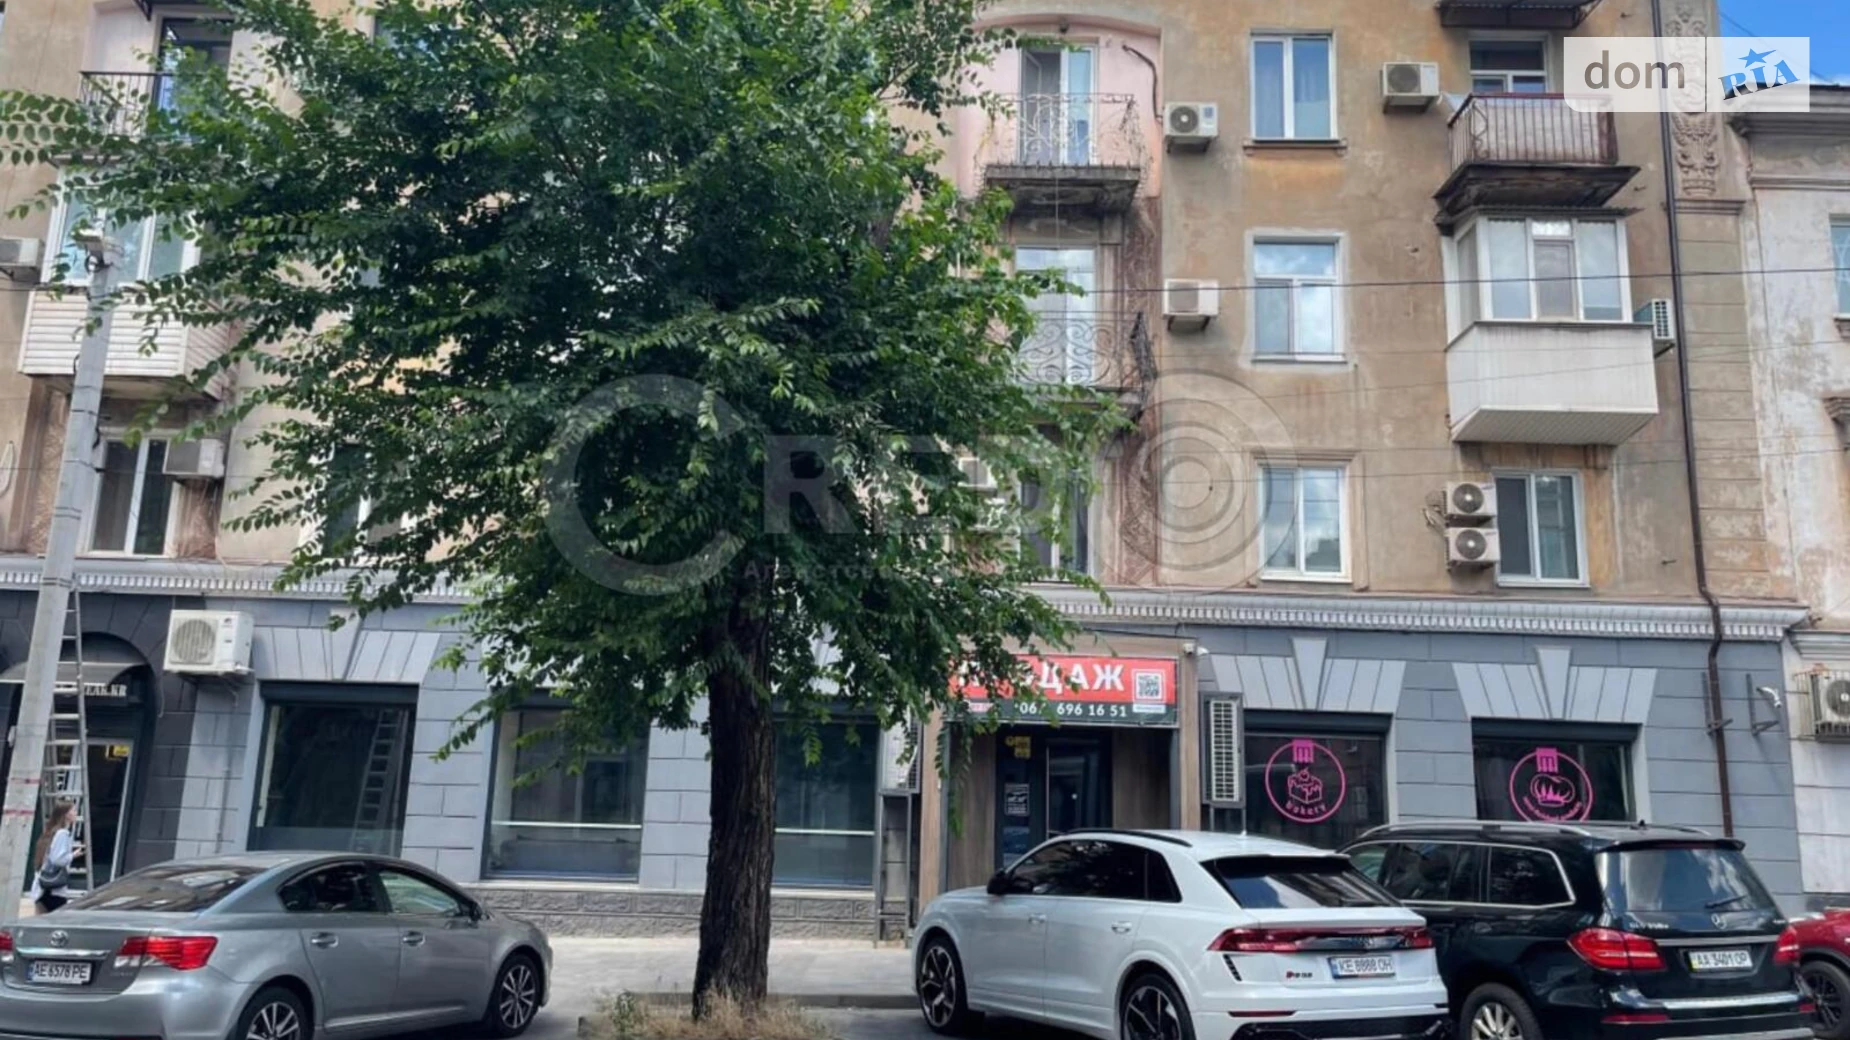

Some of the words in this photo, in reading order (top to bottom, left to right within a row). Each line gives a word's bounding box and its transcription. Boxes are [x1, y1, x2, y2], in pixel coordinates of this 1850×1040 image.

[957, 660, 1125, 694] ПОДАЖ
[1057, 703, 1082, 716] 696
[1089, 704, 1105, 716] 16
[1109, 705, 1127, 717] 51
[72, 964, 88, 979] PE
